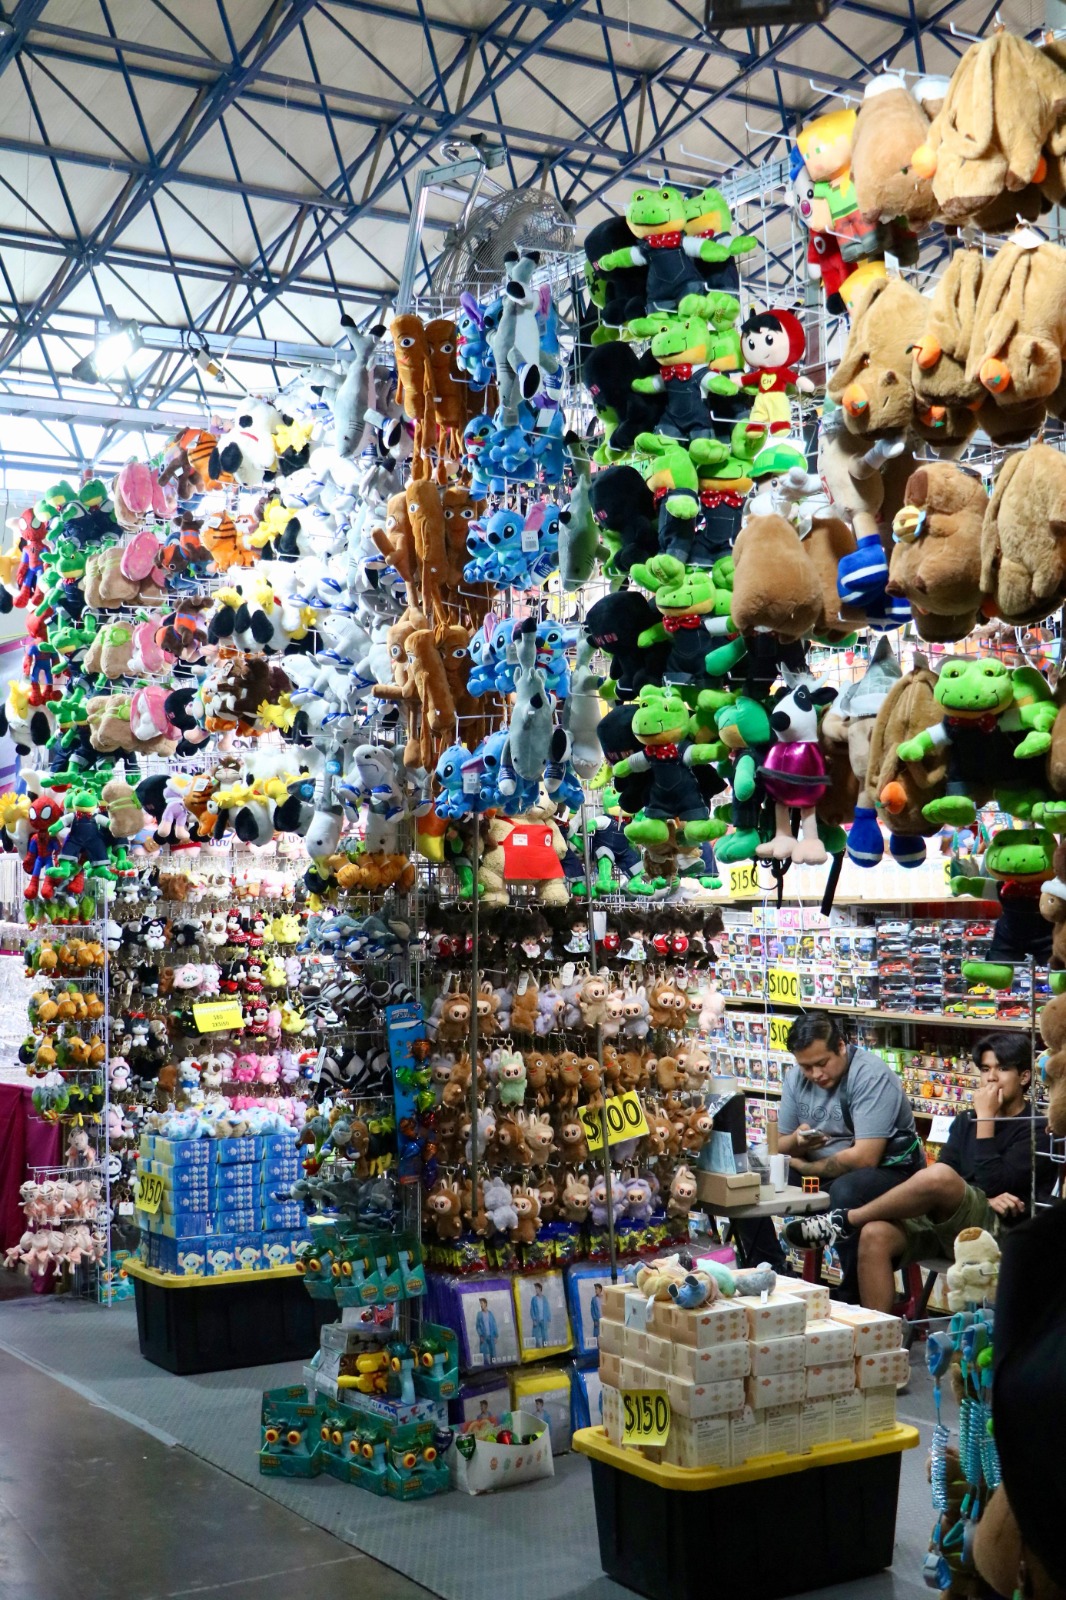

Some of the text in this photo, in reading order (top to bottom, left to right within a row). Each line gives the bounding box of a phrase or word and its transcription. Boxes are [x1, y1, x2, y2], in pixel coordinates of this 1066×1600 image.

[730, 869, 759, 891] $150
[769, 973, 798, 997] $100
[770, 1022, 789, 1042] $10
[138, 1174, 163, 1206] $150
[623, 1394, 671, 1437] $150
